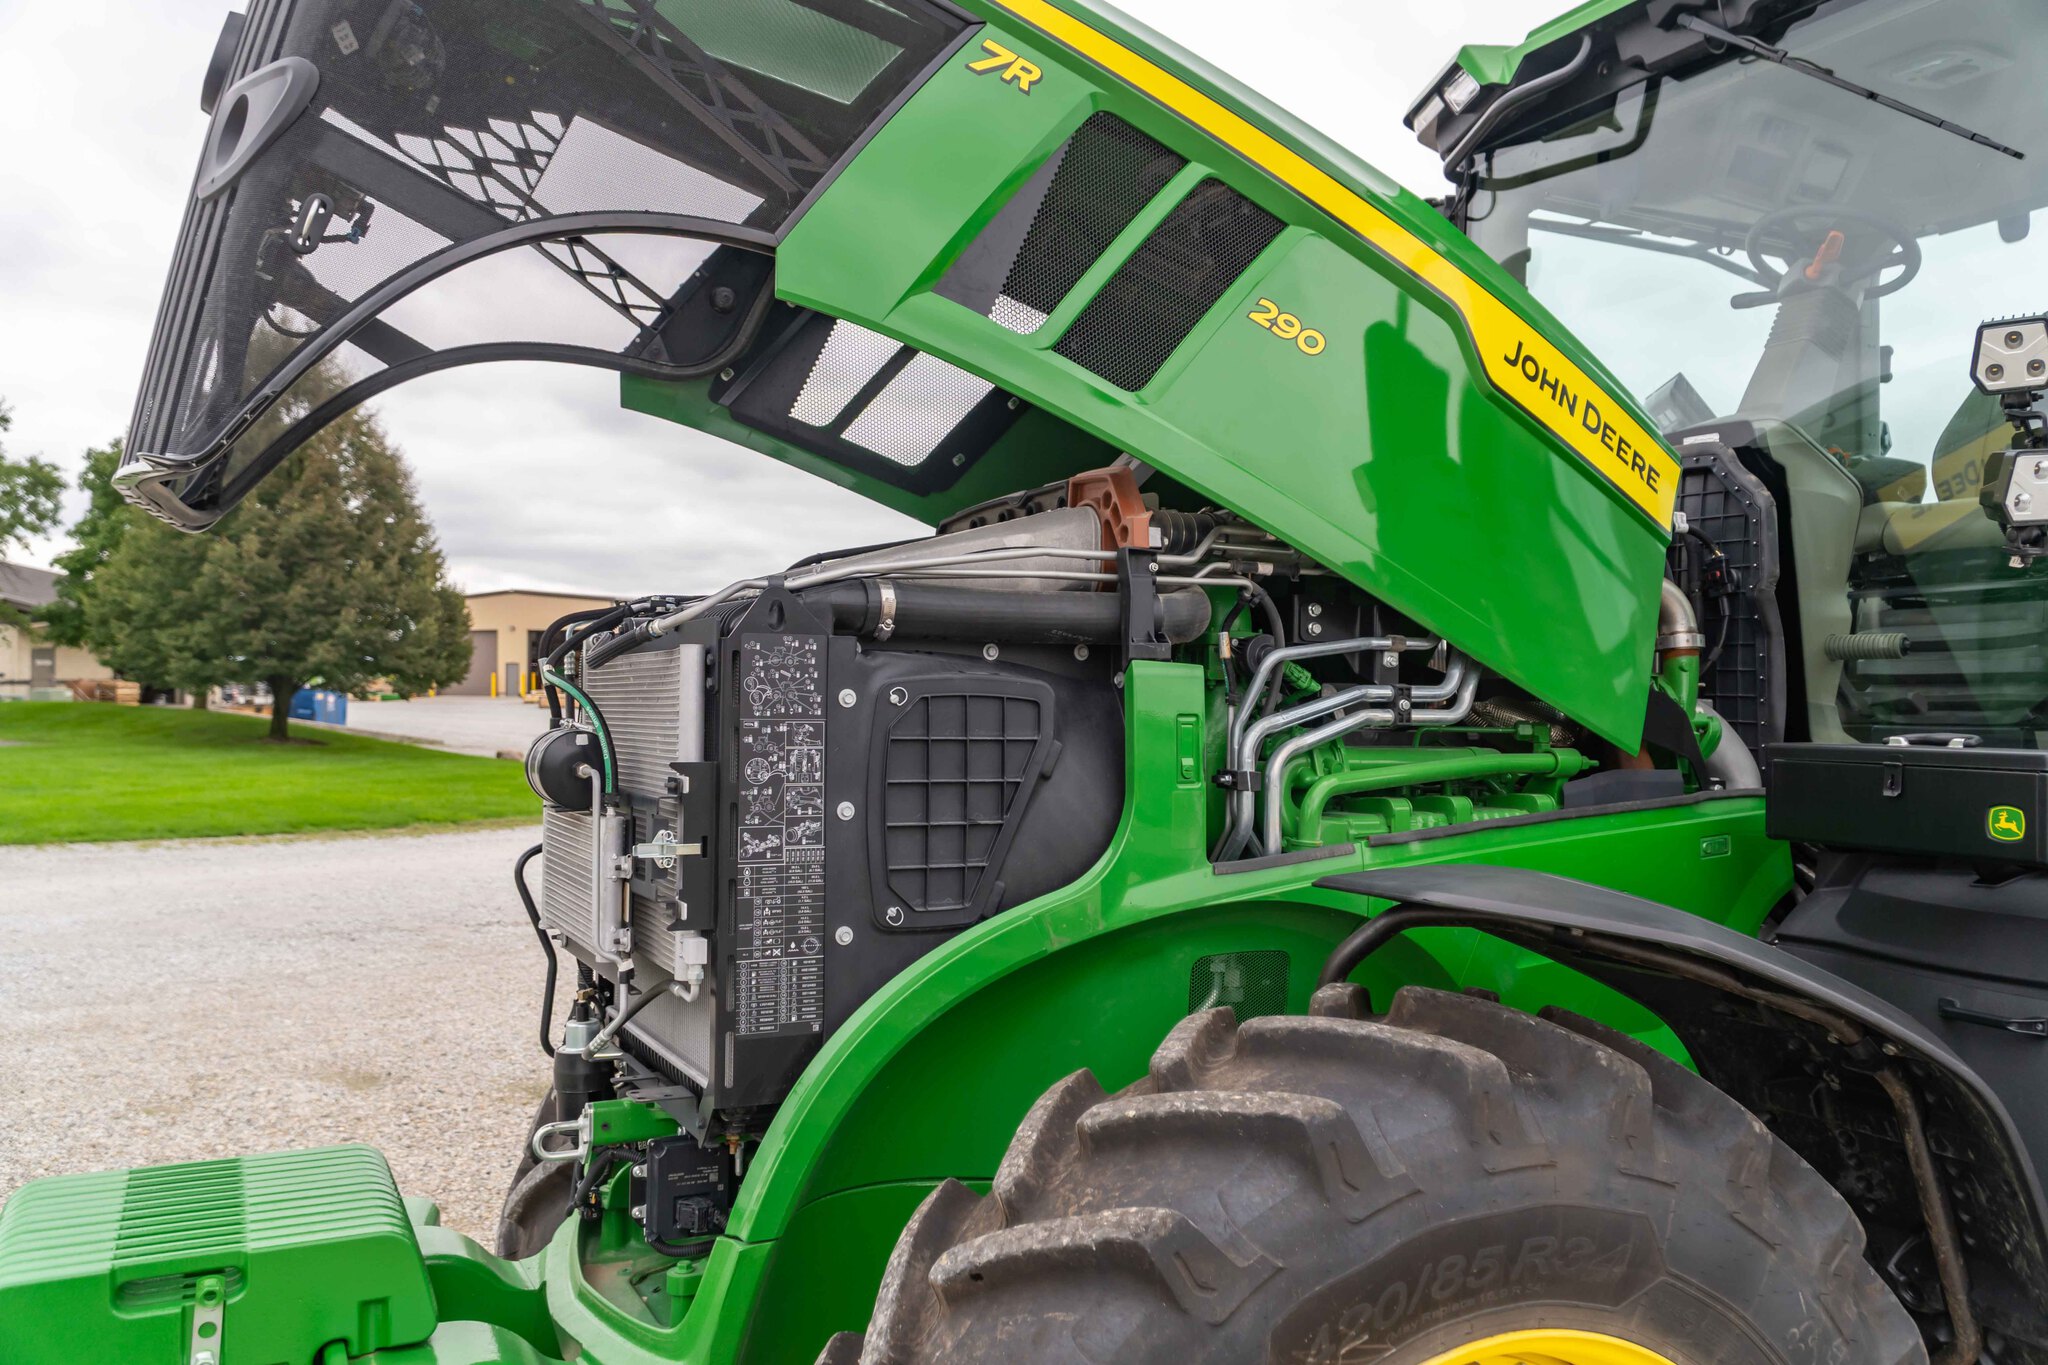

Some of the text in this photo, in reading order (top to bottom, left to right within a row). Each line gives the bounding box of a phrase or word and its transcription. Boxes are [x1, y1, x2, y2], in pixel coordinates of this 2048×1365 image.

[966, 38, 1043, 95] 7R
[1247, 297, 1327, 356] 290
[1503, 340, 1661, 495] JOHN DEERE
